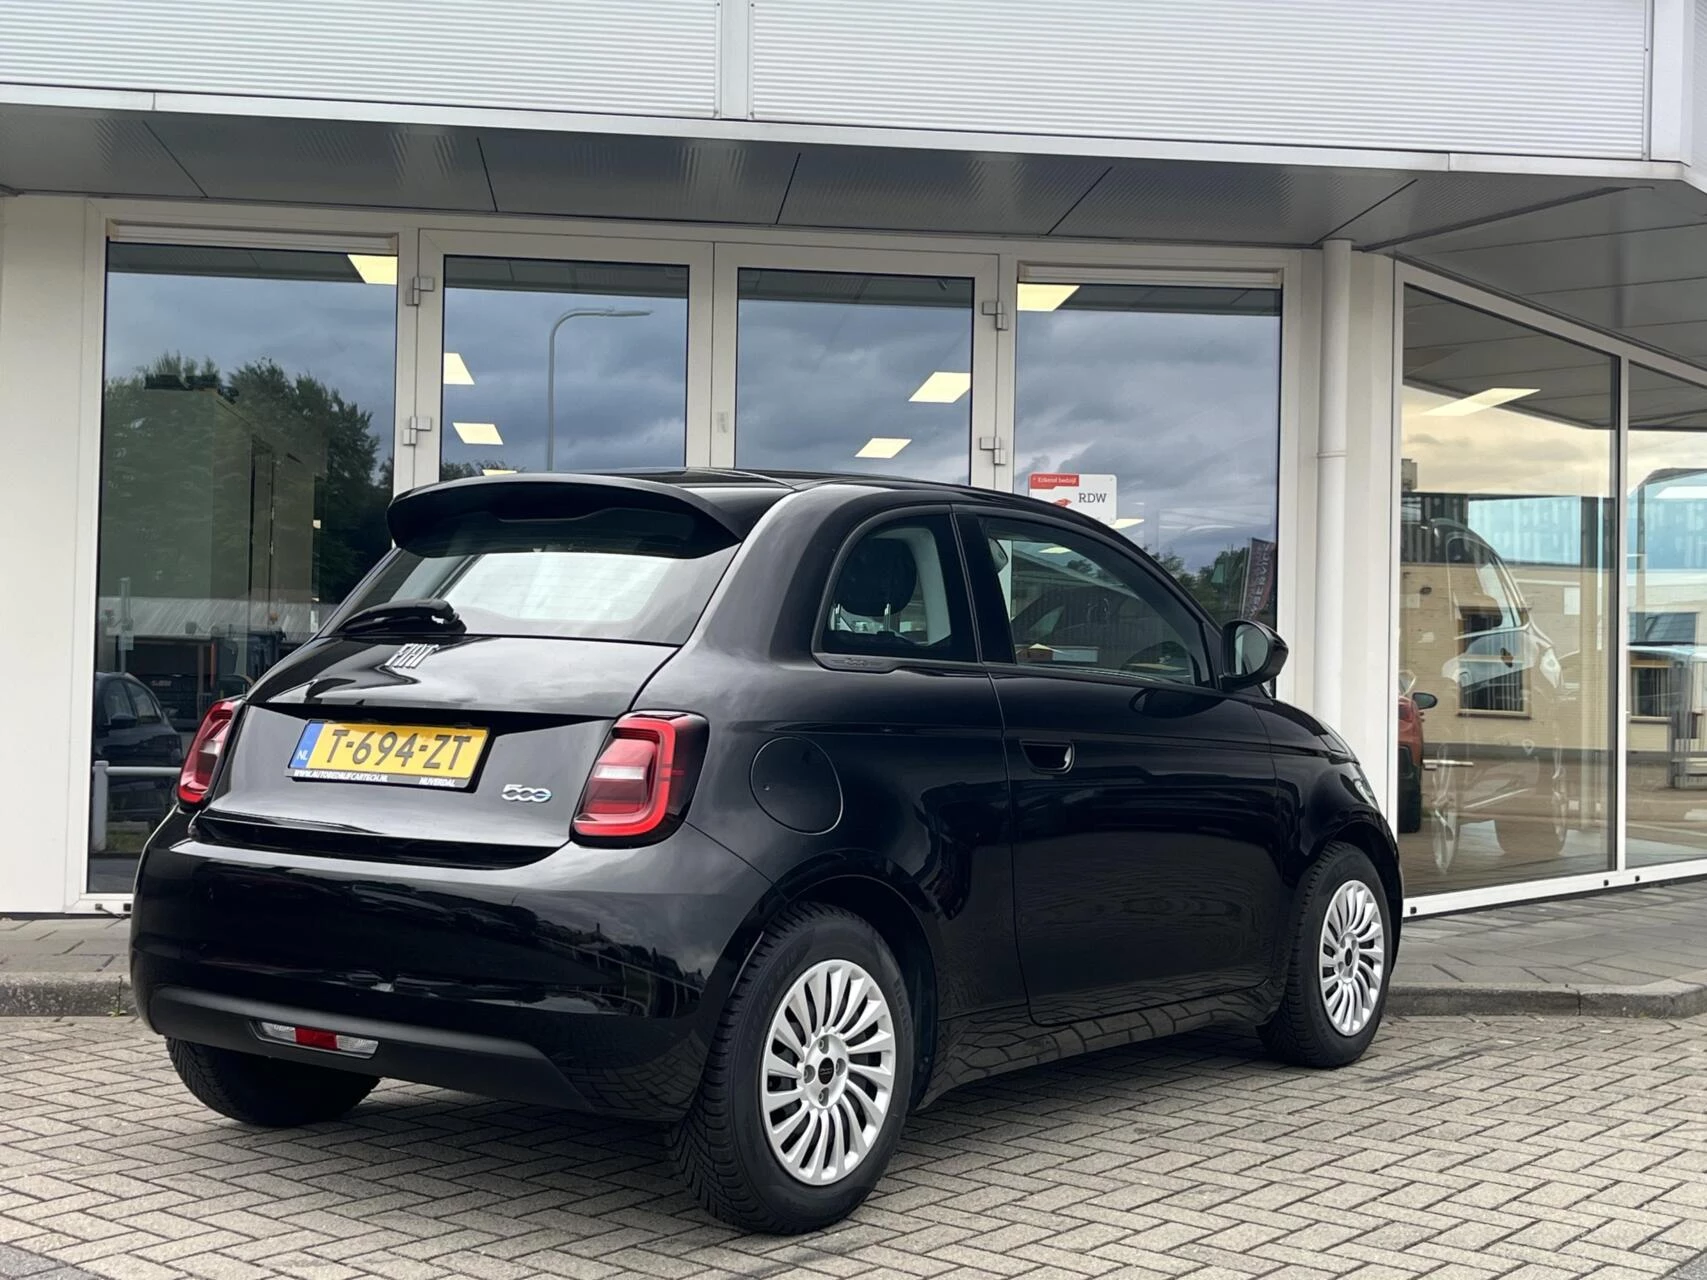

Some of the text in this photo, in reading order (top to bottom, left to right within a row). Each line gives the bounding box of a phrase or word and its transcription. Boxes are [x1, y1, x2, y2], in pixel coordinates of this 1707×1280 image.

[1078, 492, 1107, 504] RDW
[385, 643, 440, 667] FIAT
[297, 750, 308, 760] NL
[327, 730, 471, 770] T-694-ZT
[501, 784, 552, 803] 500
